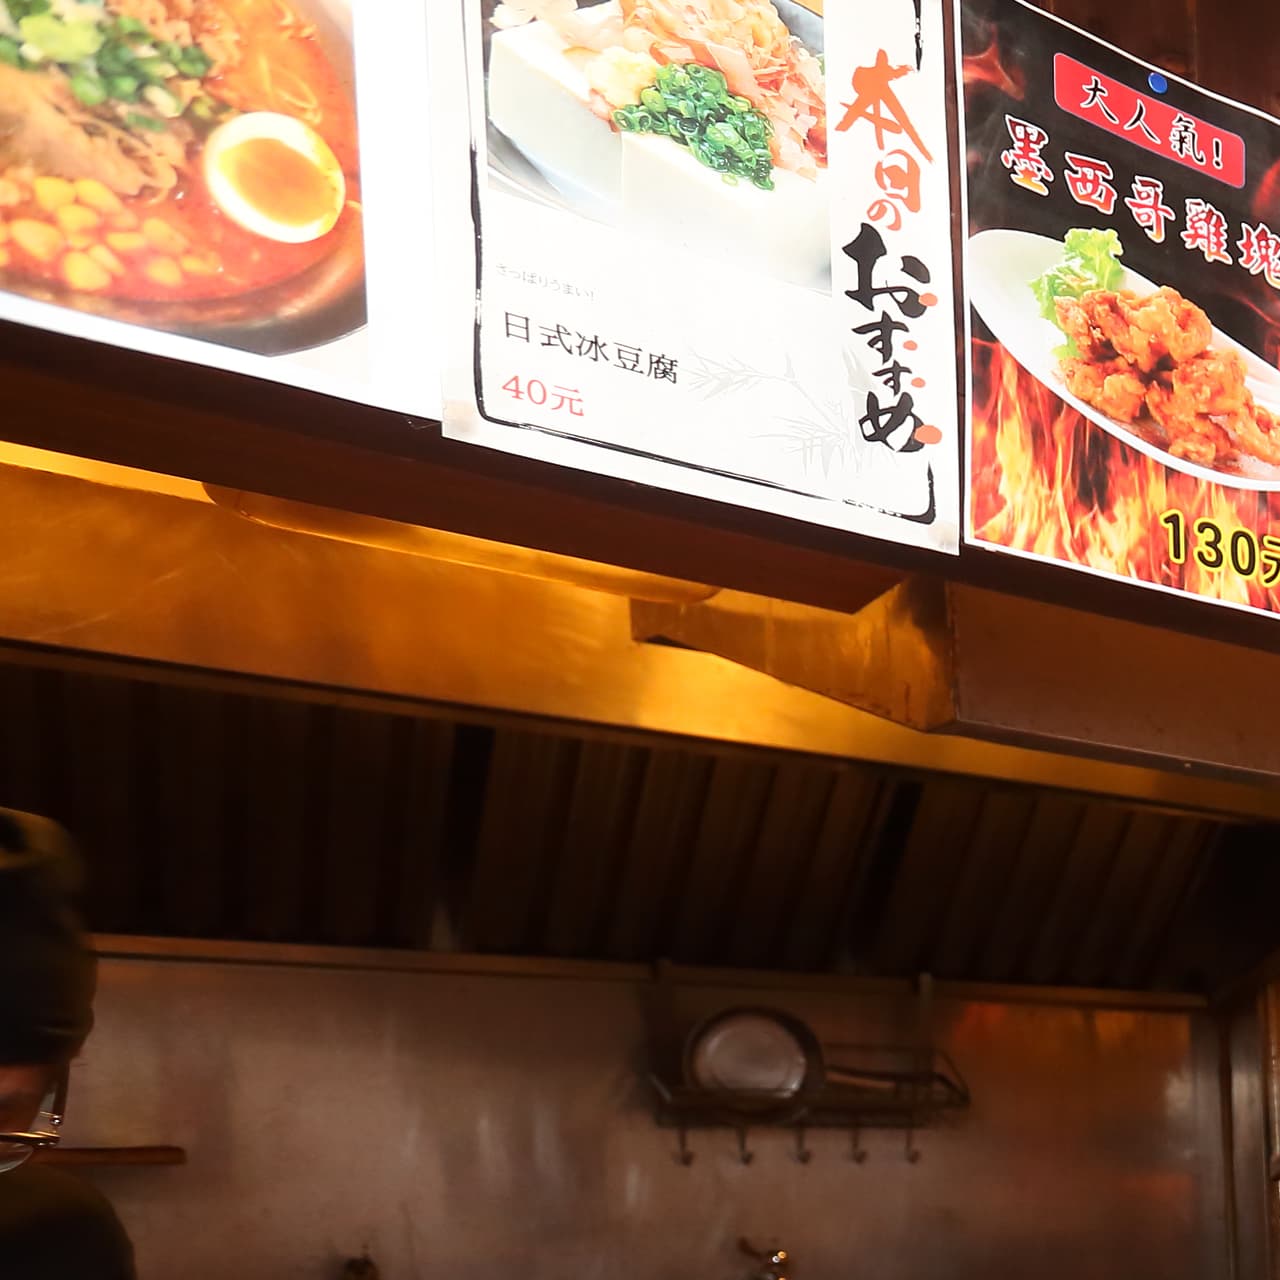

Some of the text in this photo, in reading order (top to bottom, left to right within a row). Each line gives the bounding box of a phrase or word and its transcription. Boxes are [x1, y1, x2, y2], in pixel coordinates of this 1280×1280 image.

[1080, 75, 1224, 169] 大人氣!
[505, 311, 678, 384] 日式冰豆腐
[502, 375, 584, 416] 40元
